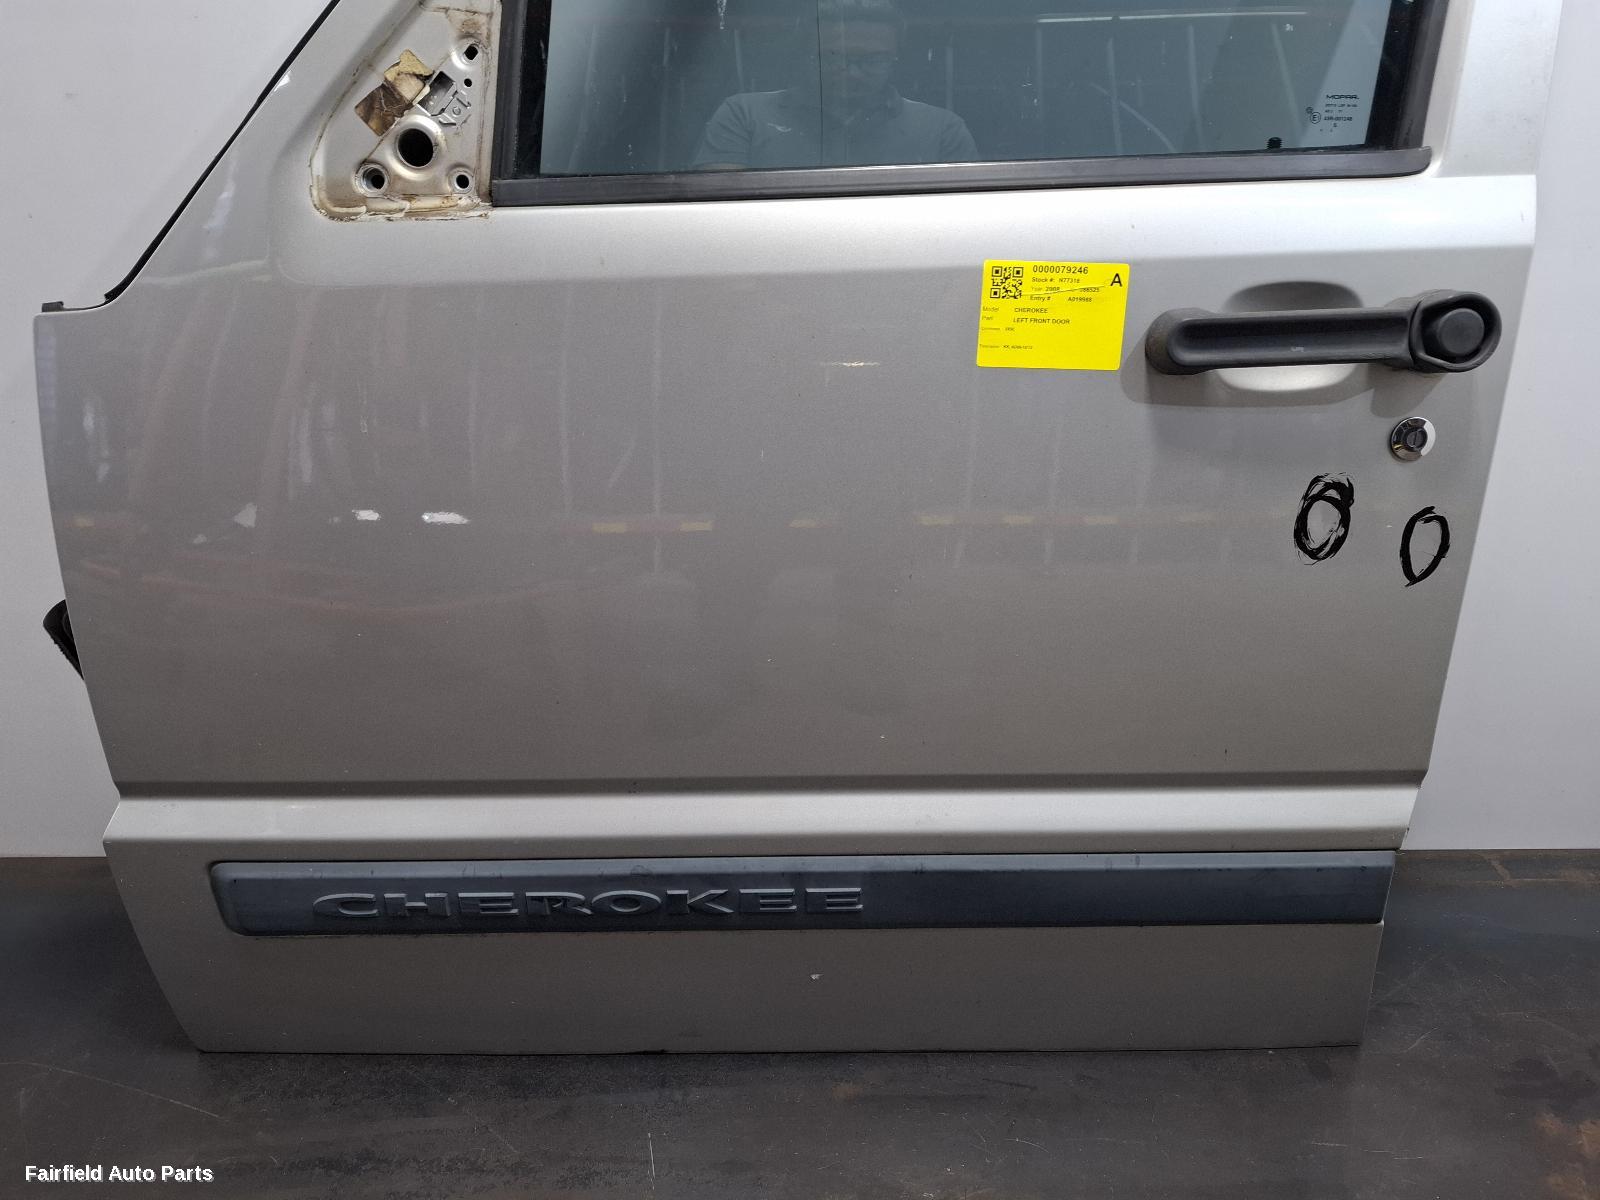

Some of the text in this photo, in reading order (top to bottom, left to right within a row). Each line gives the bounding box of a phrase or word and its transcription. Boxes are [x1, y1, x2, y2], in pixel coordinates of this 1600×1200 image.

[1032, 264, 1089, 275] 0000079246
[1110, 273, 1123, 287] A
[312, 887, 865, 919] CHEROKEE
